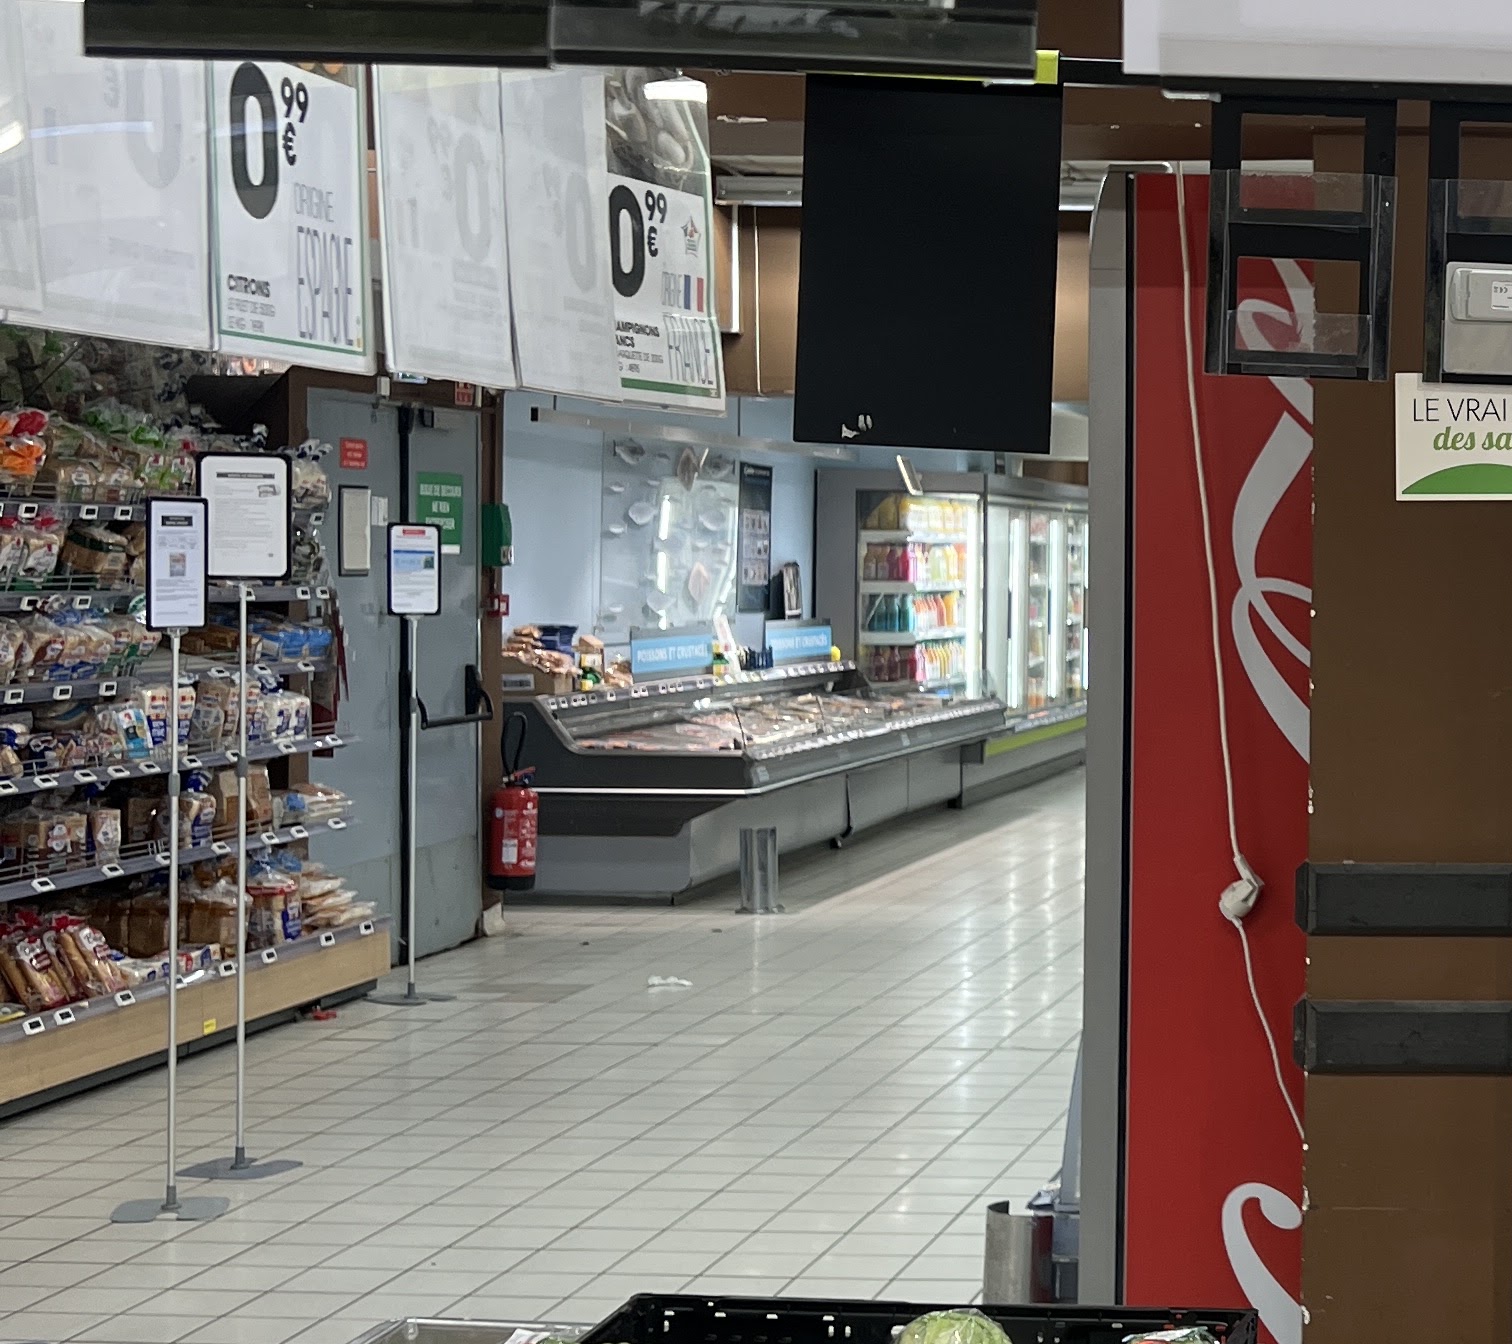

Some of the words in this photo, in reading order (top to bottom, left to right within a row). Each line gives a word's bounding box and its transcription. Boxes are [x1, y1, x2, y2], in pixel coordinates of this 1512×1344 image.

[229, 60, 280, 220] 0
[281, 76, 309, 124] 99
[282, 121, 297, 167] €
[609, 184, 646, 298] 0
[645, 189, 668, 224] 99
[647, 225, 659, 258] €
[226, 273, 271, 299] CITRONS
[615, 319, 660, 338] AMPIGNONS
[615, 333, 636, 348] ANCS
[1412, 397, 1440, 424] LE
[1446, 397, 1508, 424] VRAI
[1432, 425, 1476, 452] des
